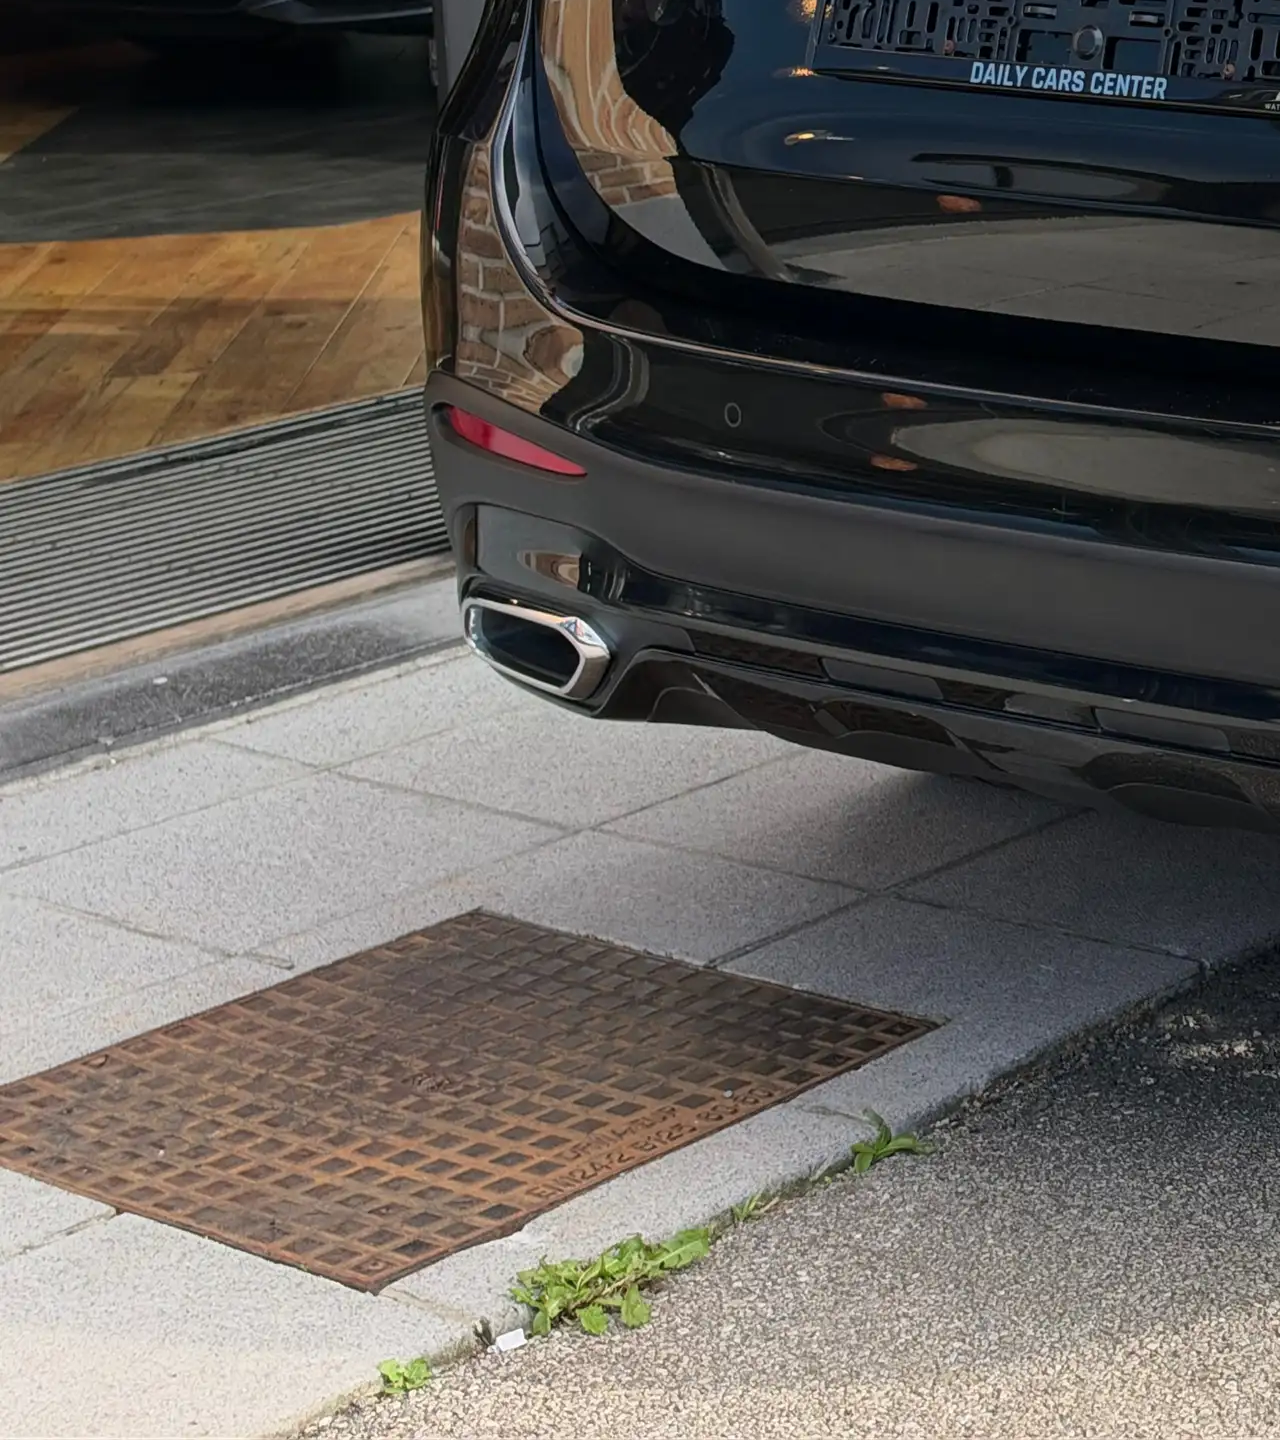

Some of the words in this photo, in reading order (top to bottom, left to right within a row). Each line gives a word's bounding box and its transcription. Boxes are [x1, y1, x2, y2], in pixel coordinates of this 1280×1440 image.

[969, 61, 1029, 88] DAILY
[1031, 67, 1085, 93] CARS
[1090, 72, 1168, 101] CENTER
